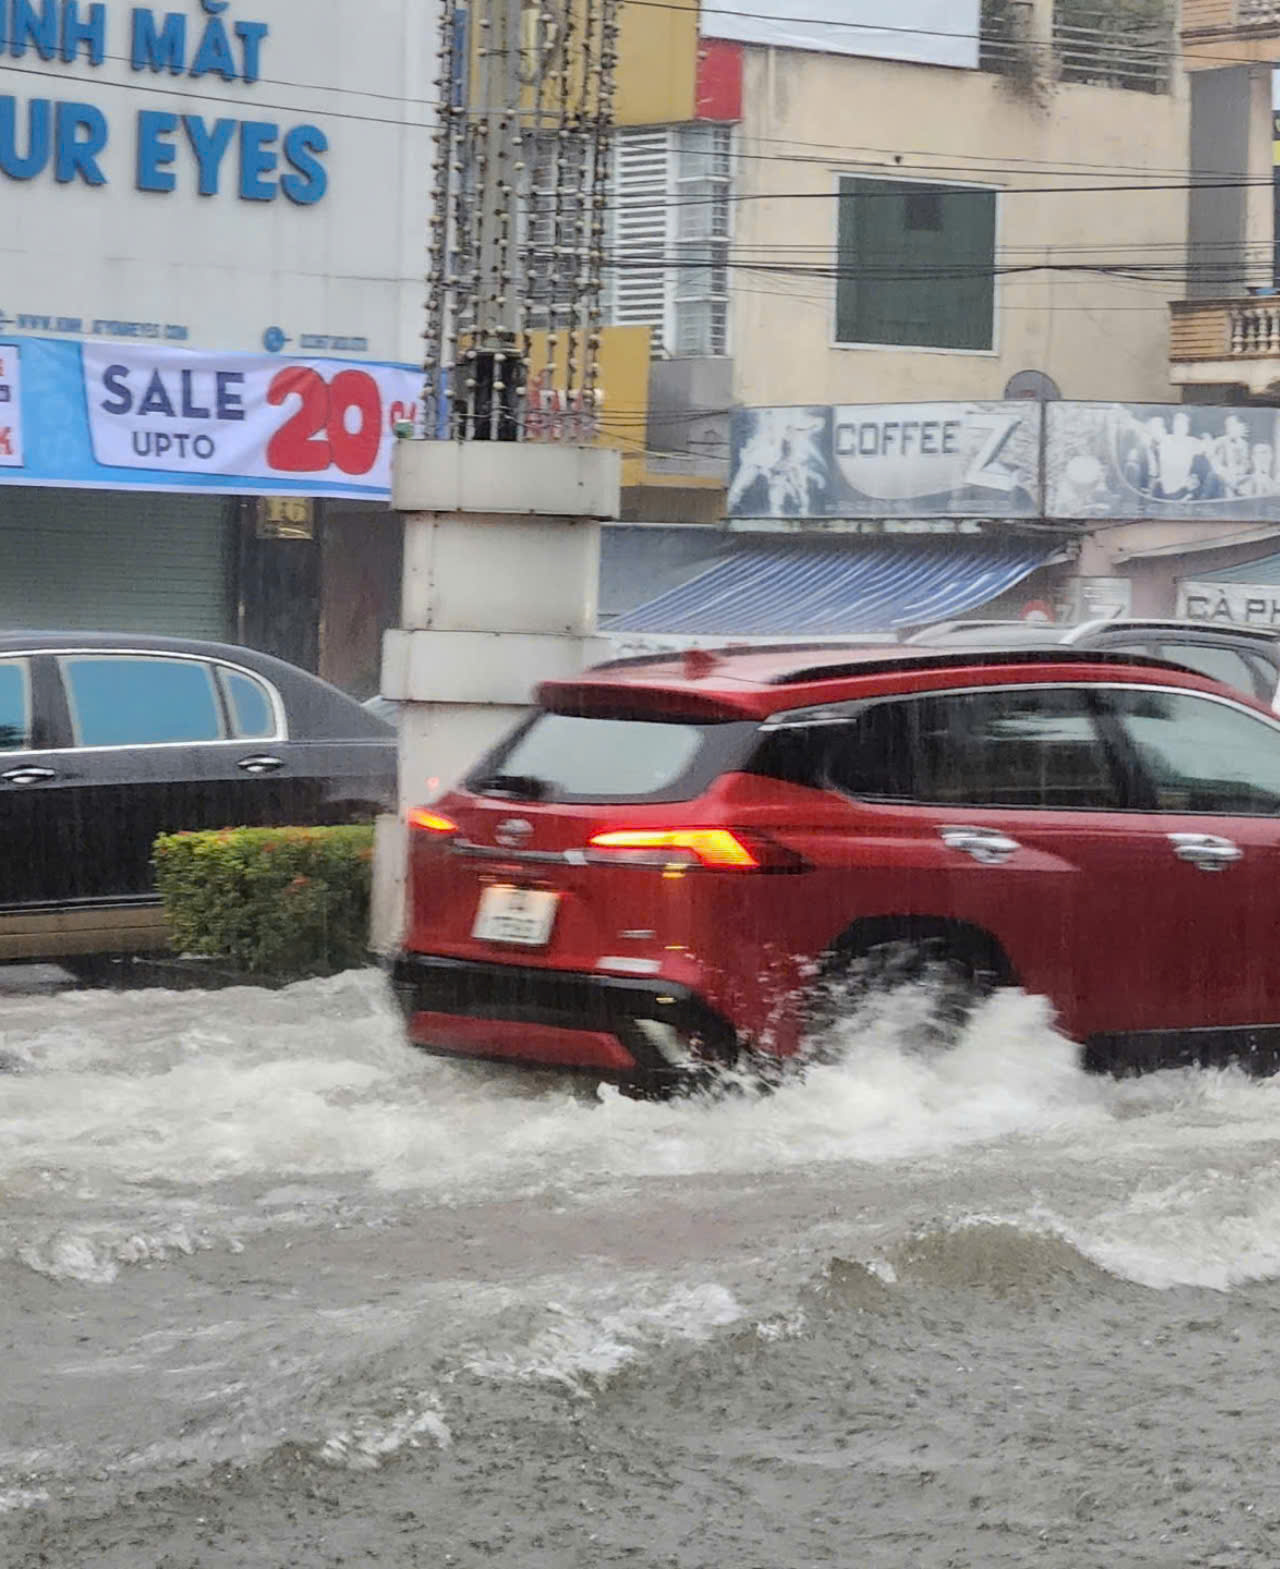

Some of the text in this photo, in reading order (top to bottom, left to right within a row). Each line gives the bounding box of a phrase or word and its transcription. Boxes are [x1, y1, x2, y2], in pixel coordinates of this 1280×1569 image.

[0, 95, 329, 205] UR EYES
[101, 364, 246, 420] SALE
[266, 365, 382, 475] 20
[835, 420, 961, 456] COFFEE
[132, 430, 216, 460] UPTO
[1185, 589, 1233, 622] CÀ
